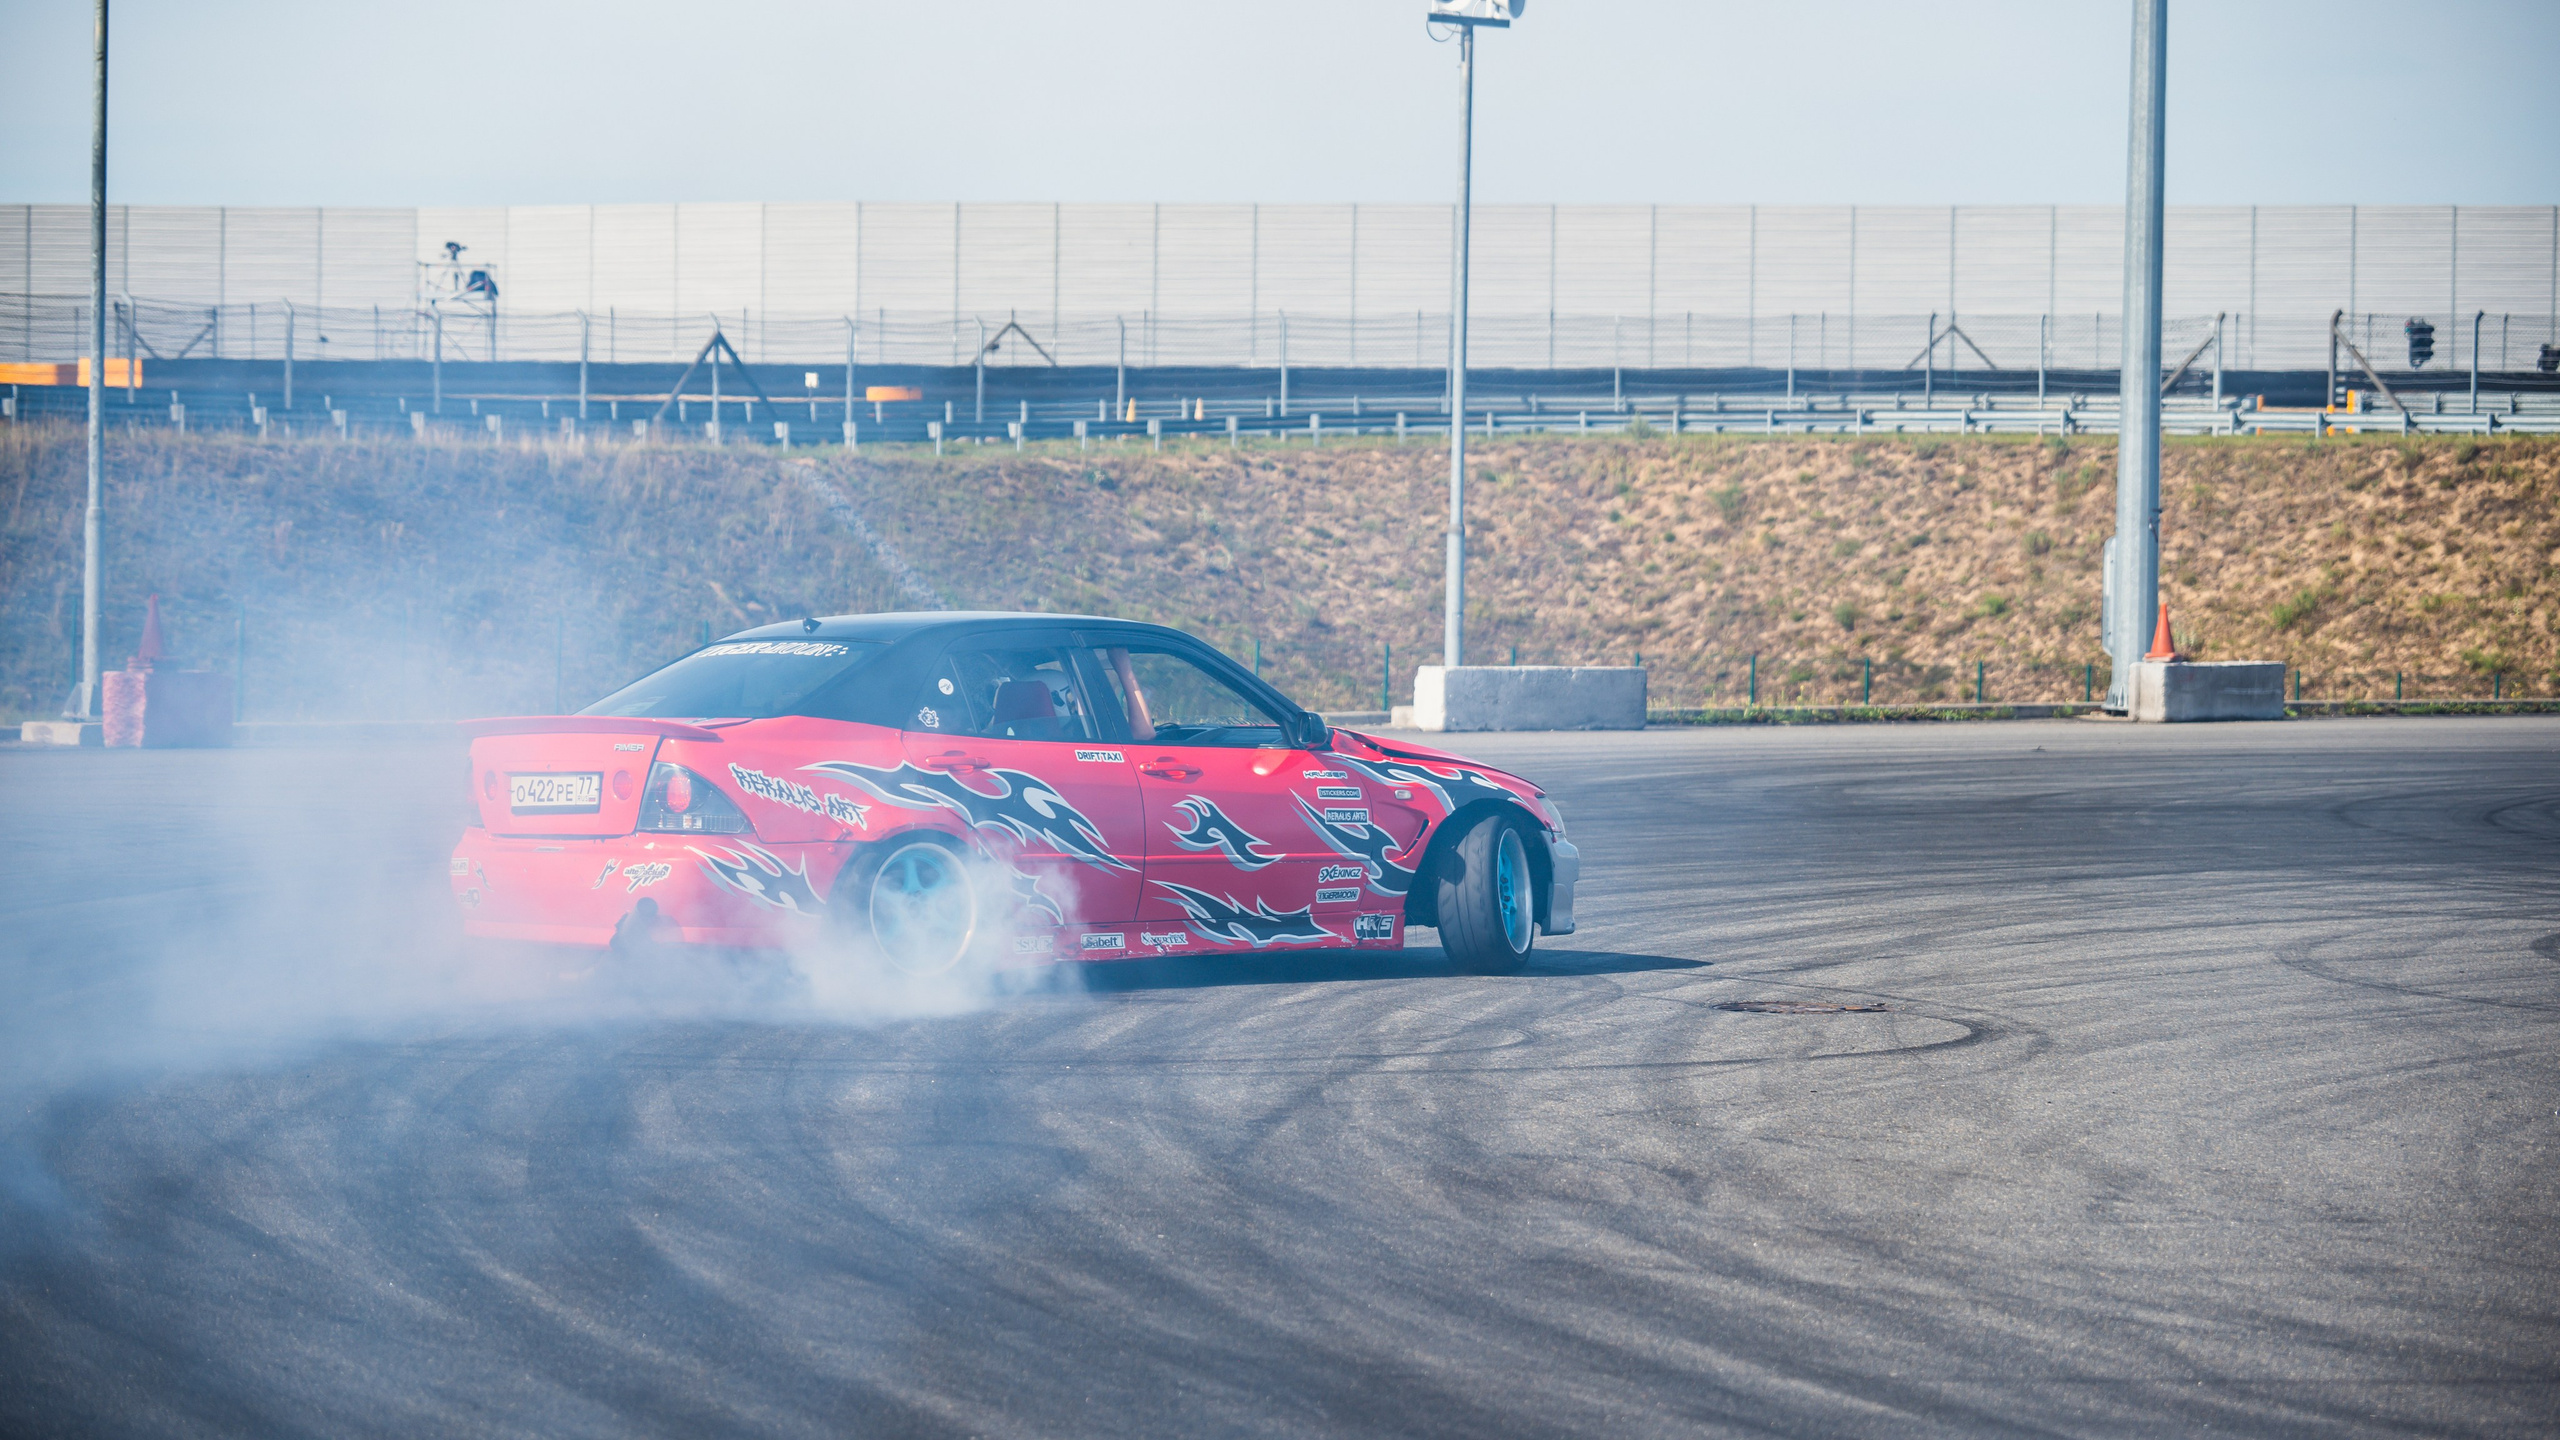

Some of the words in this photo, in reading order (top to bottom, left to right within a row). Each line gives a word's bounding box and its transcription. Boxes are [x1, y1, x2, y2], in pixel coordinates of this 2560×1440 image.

[1076, 751, 1100, 760] DRIFT
[1100, 752, 1123, 761] TAXI
[578, 776, 594, 795] 77
[825, 794, 868, 828] ART
[1356, 915, 1393, 931] HKS
[1086, 936, 1118, 947] Sabelt
